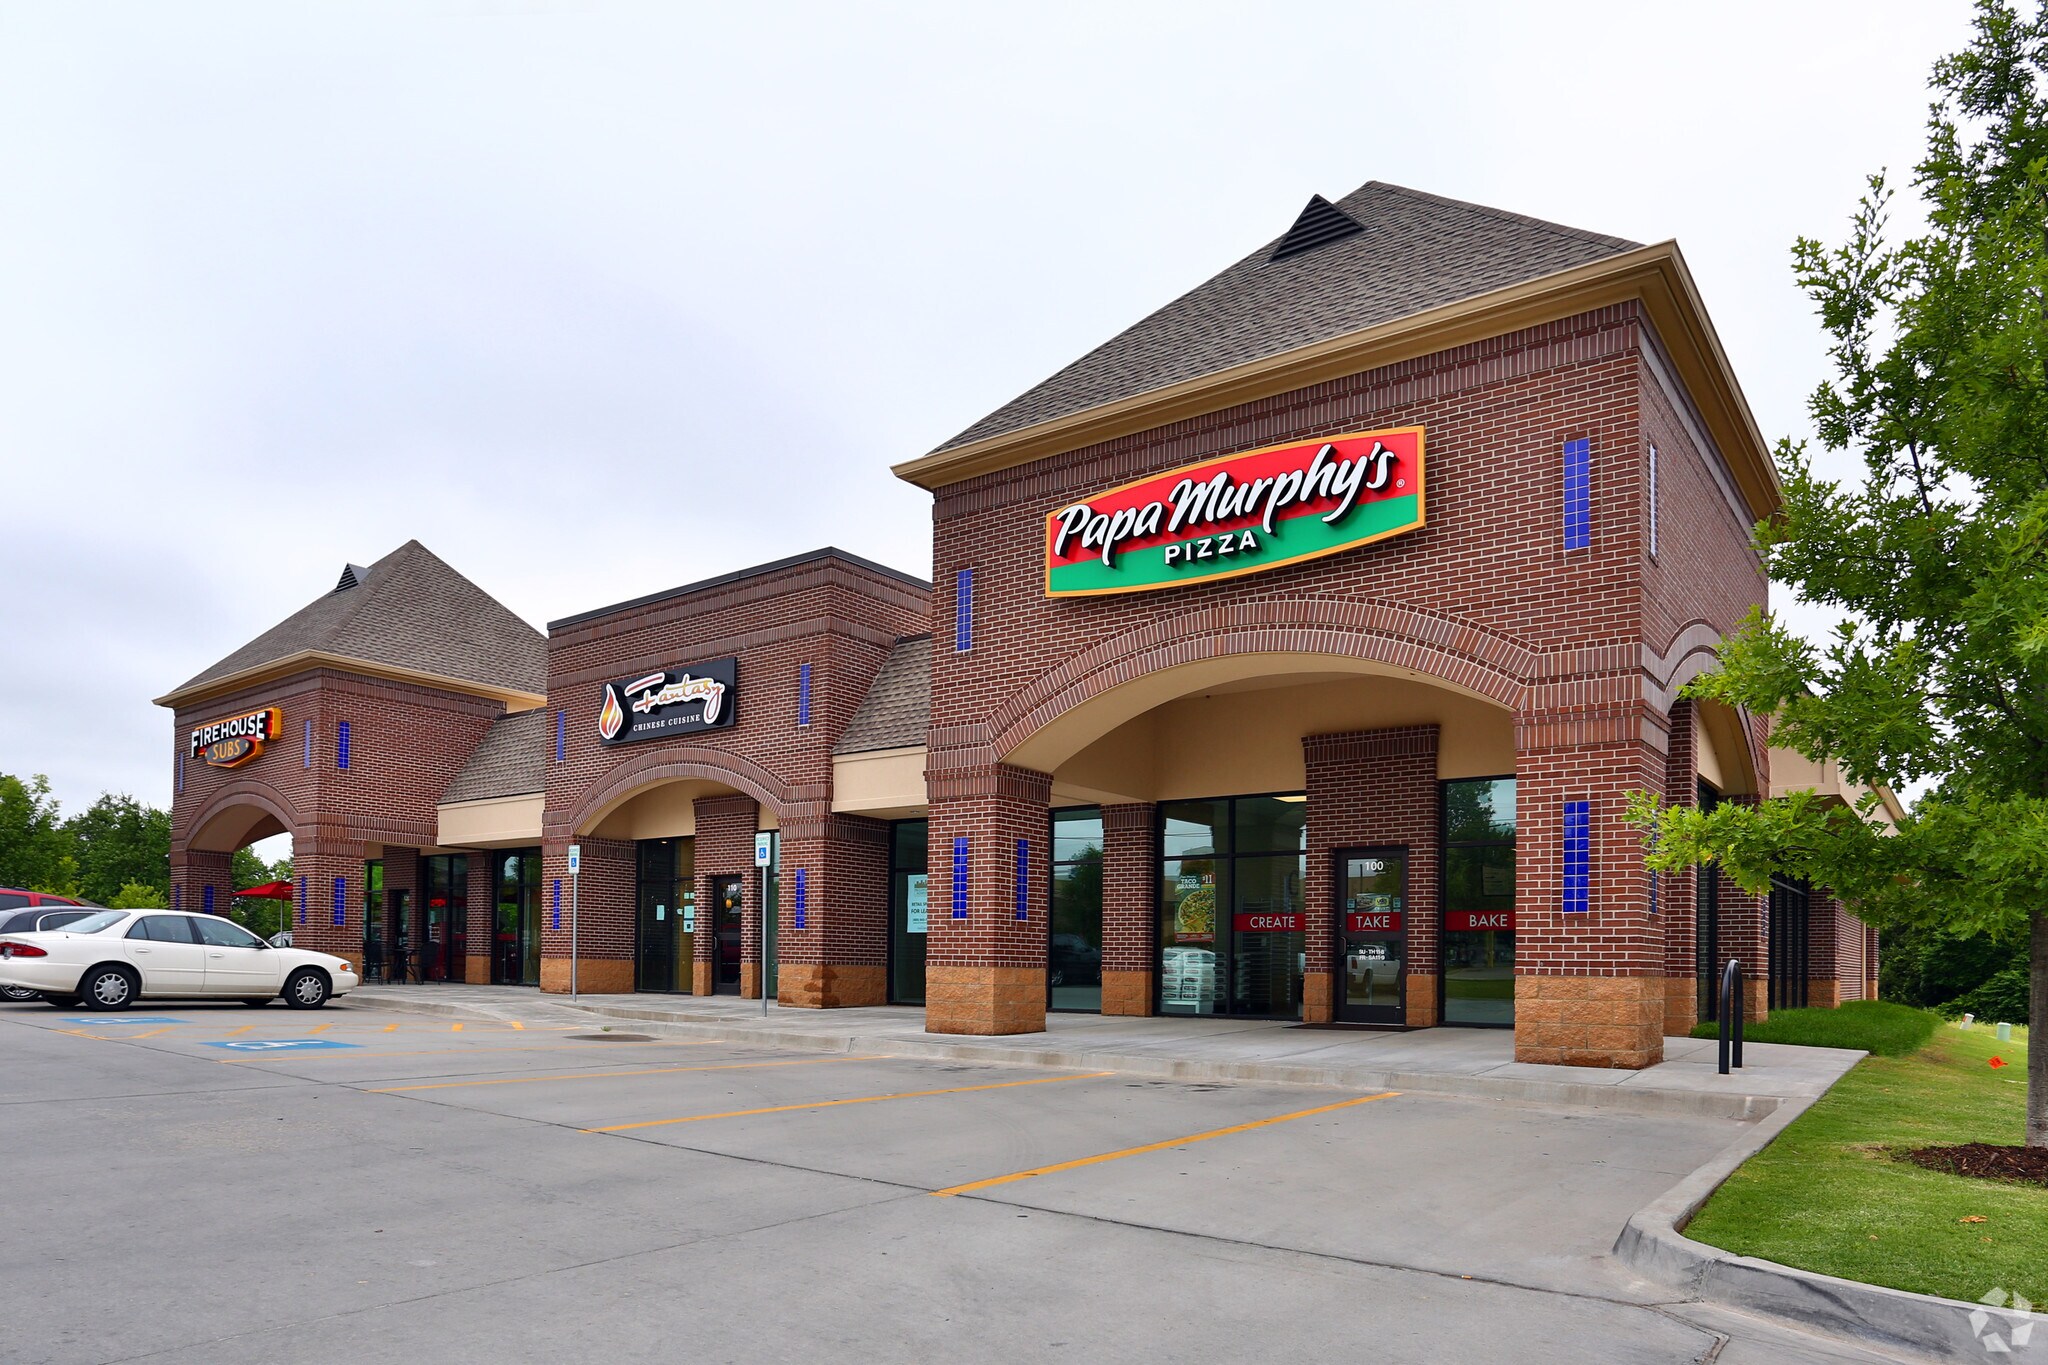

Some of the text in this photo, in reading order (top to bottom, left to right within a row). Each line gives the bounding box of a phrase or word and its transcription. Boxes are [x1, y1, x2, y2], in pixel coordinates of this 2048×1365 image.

[1054, 441, 1395, 567] Papa Murphy's
[1164, 530, 1257, 565] PIZZA
[624, 672, 726, 725] Fantasy
[633, 713, 701, 732] CHINESE CUISINE
[191, 711, 266, 758] FIREHOUSE
[212, 739, 241, 761] SUBS
[1364, 861, 1384, 871] 100
[1250, 916, 1296, 929] CREATE
[1355, 915, 1390, 929] TAKE
[1469, 914, 1508, 928] BAKE
